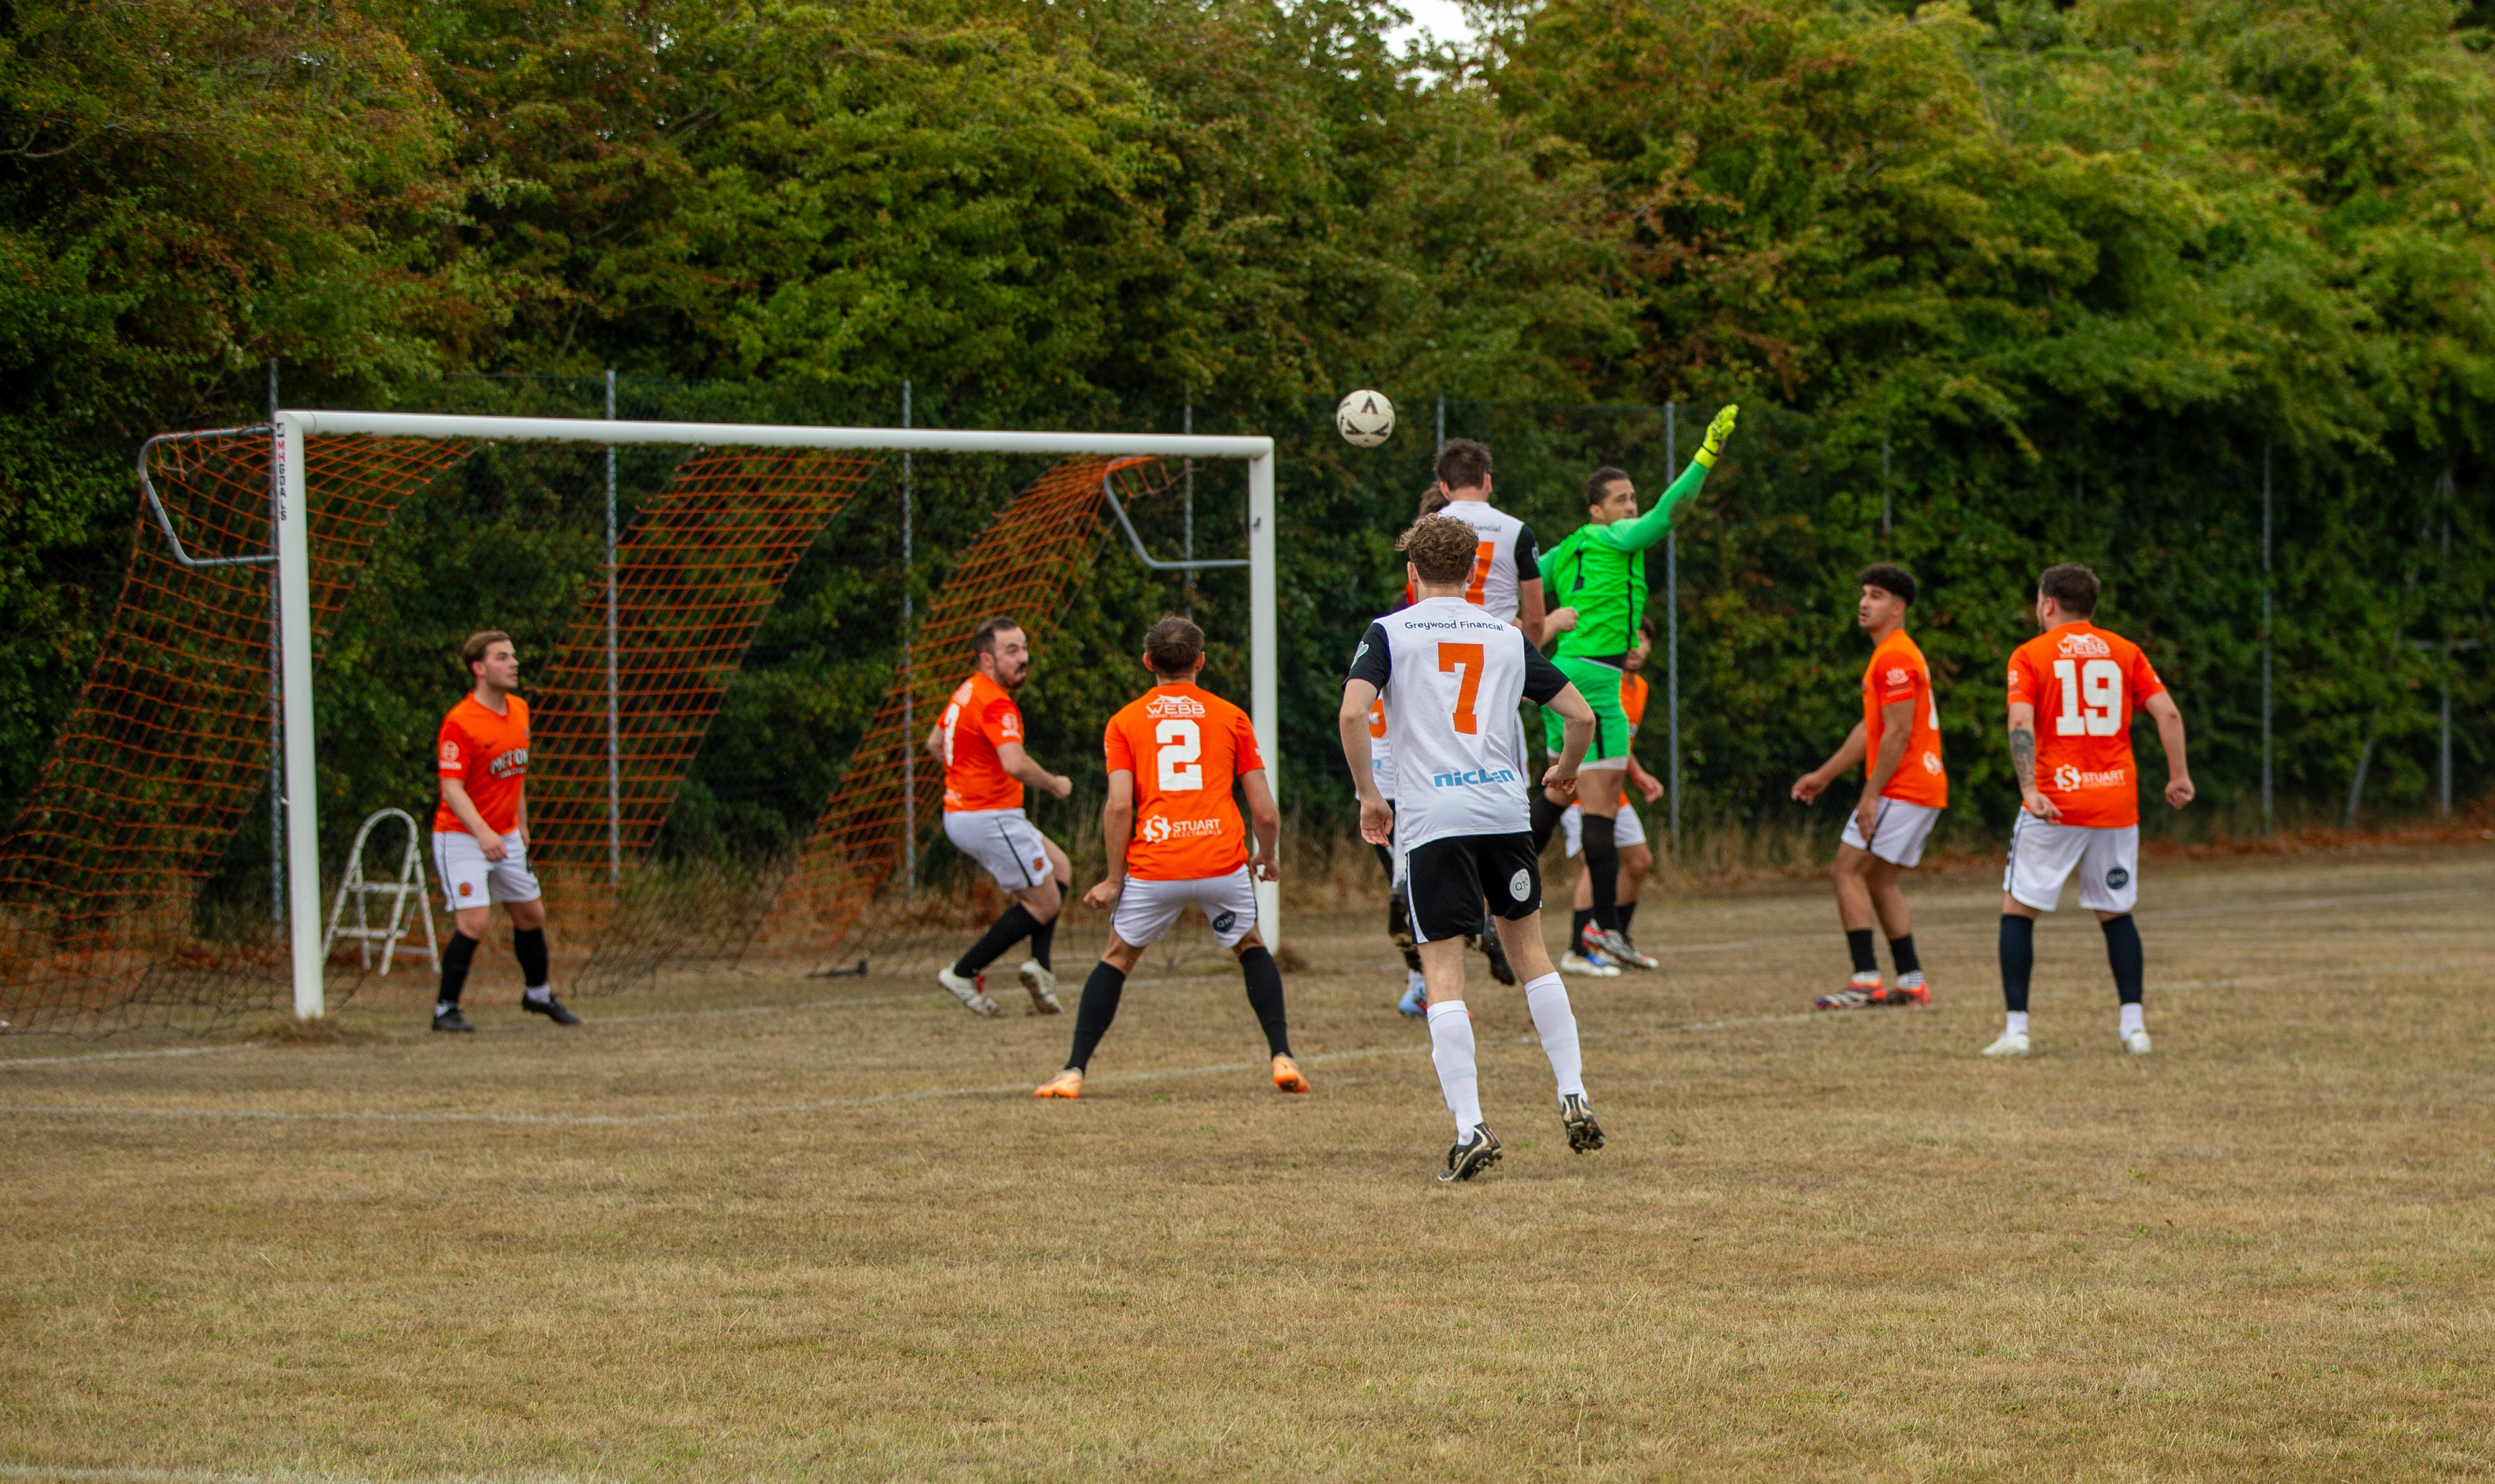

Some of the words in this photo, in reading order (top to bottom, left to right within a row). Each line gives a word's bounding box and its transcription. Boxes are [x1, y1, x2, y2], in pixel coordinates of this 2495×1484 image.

[1405, 620, 1457, 630] Greywood
[1460, 620, 1504, 632] Financial
[2057, 642, 2111, 654] WEBB
[1437, 642, 1484, 735] 7
[2053, 659, 2123, 737] 19
[1145, 703, 1205, 714] WEBB
[1156, 719, 1203, 791] 2
[2081, 769, 2124, 783] STUART
[1172, 818, 1221, 833] STUART
[1515, 878, 1528, 891] Q10
